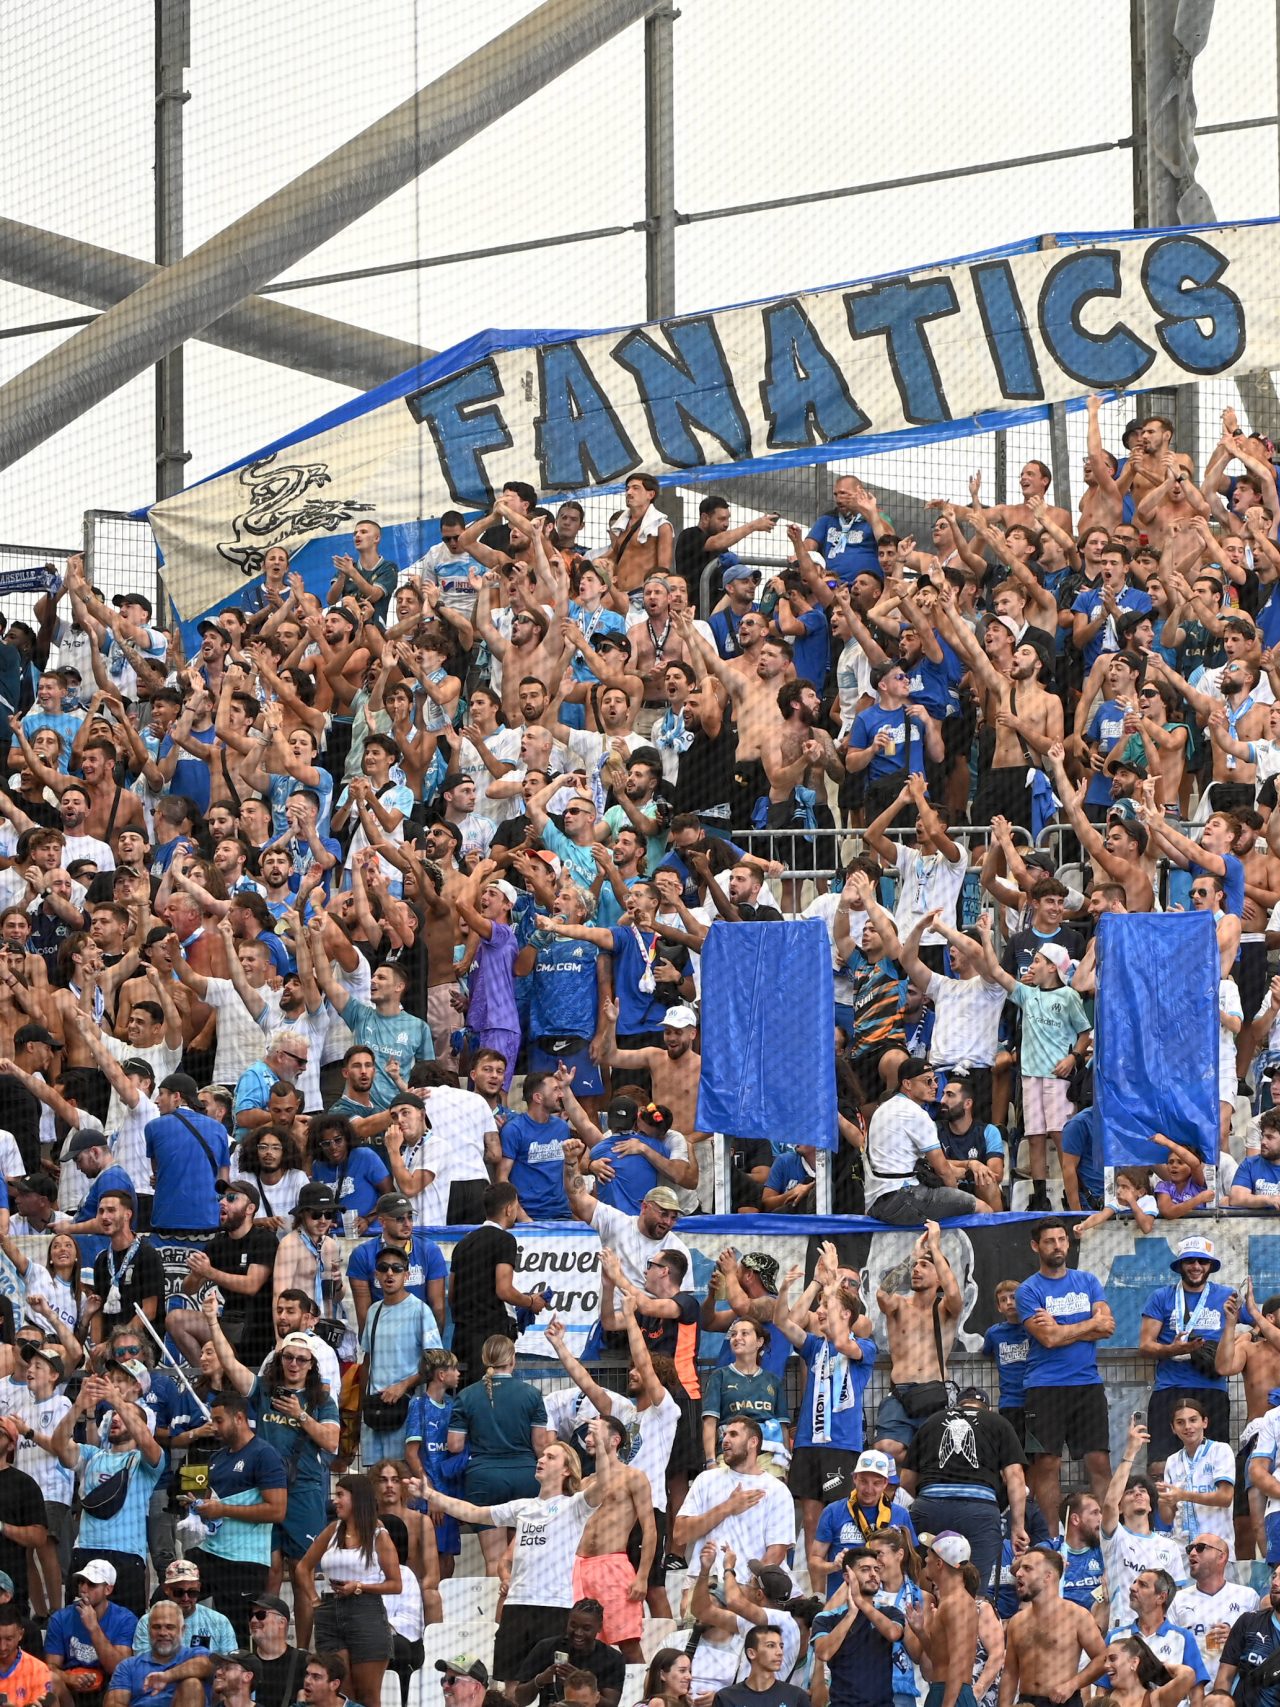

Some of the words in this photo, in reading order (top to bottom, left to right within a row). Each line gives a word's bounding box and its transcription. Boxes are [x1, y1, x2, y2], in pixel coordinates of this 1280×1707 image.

[405, 235, 1246, 511] FANATICS
[0, 570, 36, 586] ARSEILLE
[514, 1245, 602, 1274] ienve
[729, 1400, 772, 1412] CMACG
[262, 1413, 301, 1428] CMAC
[428, 1442, 449, 1452] CMA
[522, 1521, 548, 1534] Uber
[520, 1534, 547, 1547] Eats
[1123, 1558, 1147, 1573] CMA
